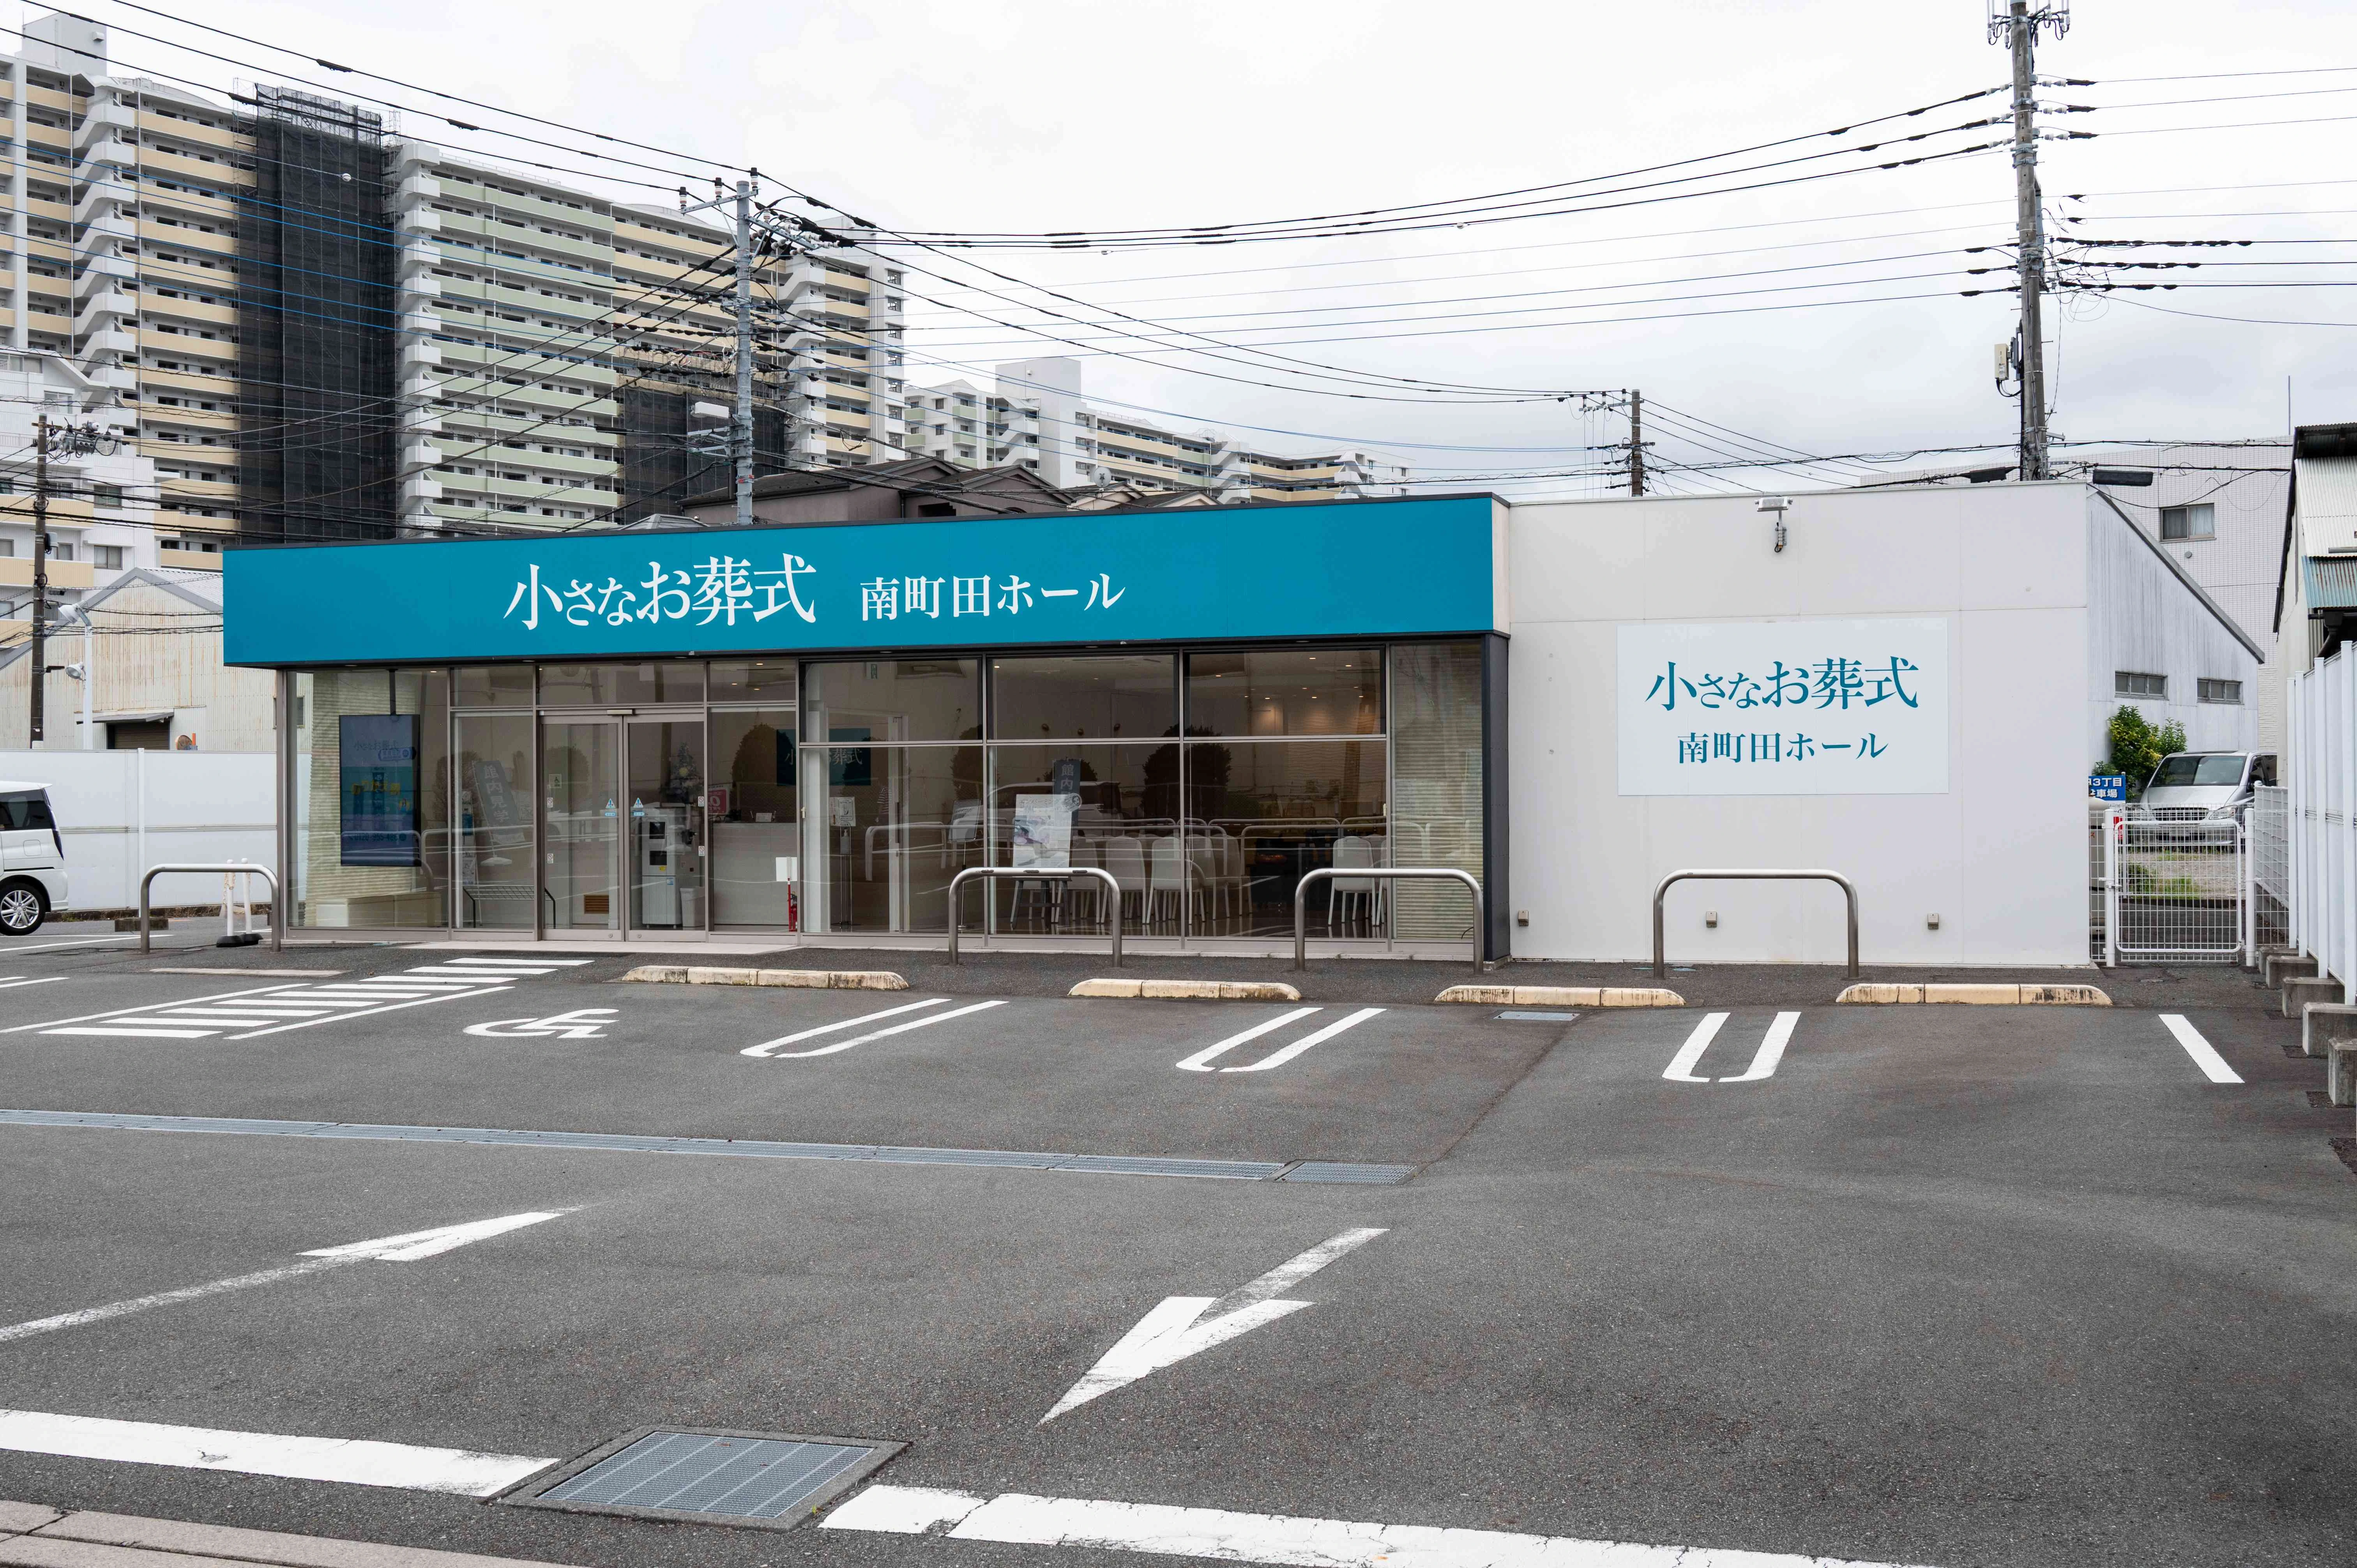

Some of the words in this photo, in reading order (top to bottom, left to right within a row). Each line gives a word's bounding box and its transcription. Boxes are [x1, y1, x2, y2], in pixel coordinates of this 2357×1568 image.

[504, 553, 816, 630] 小さなお葬式
[860, 573, 1125, 621] 南町田ホール
[1645, 656, 1919, 711] 小さなお葬式
[1678, 732, 1888, 764] 南町田ホール
